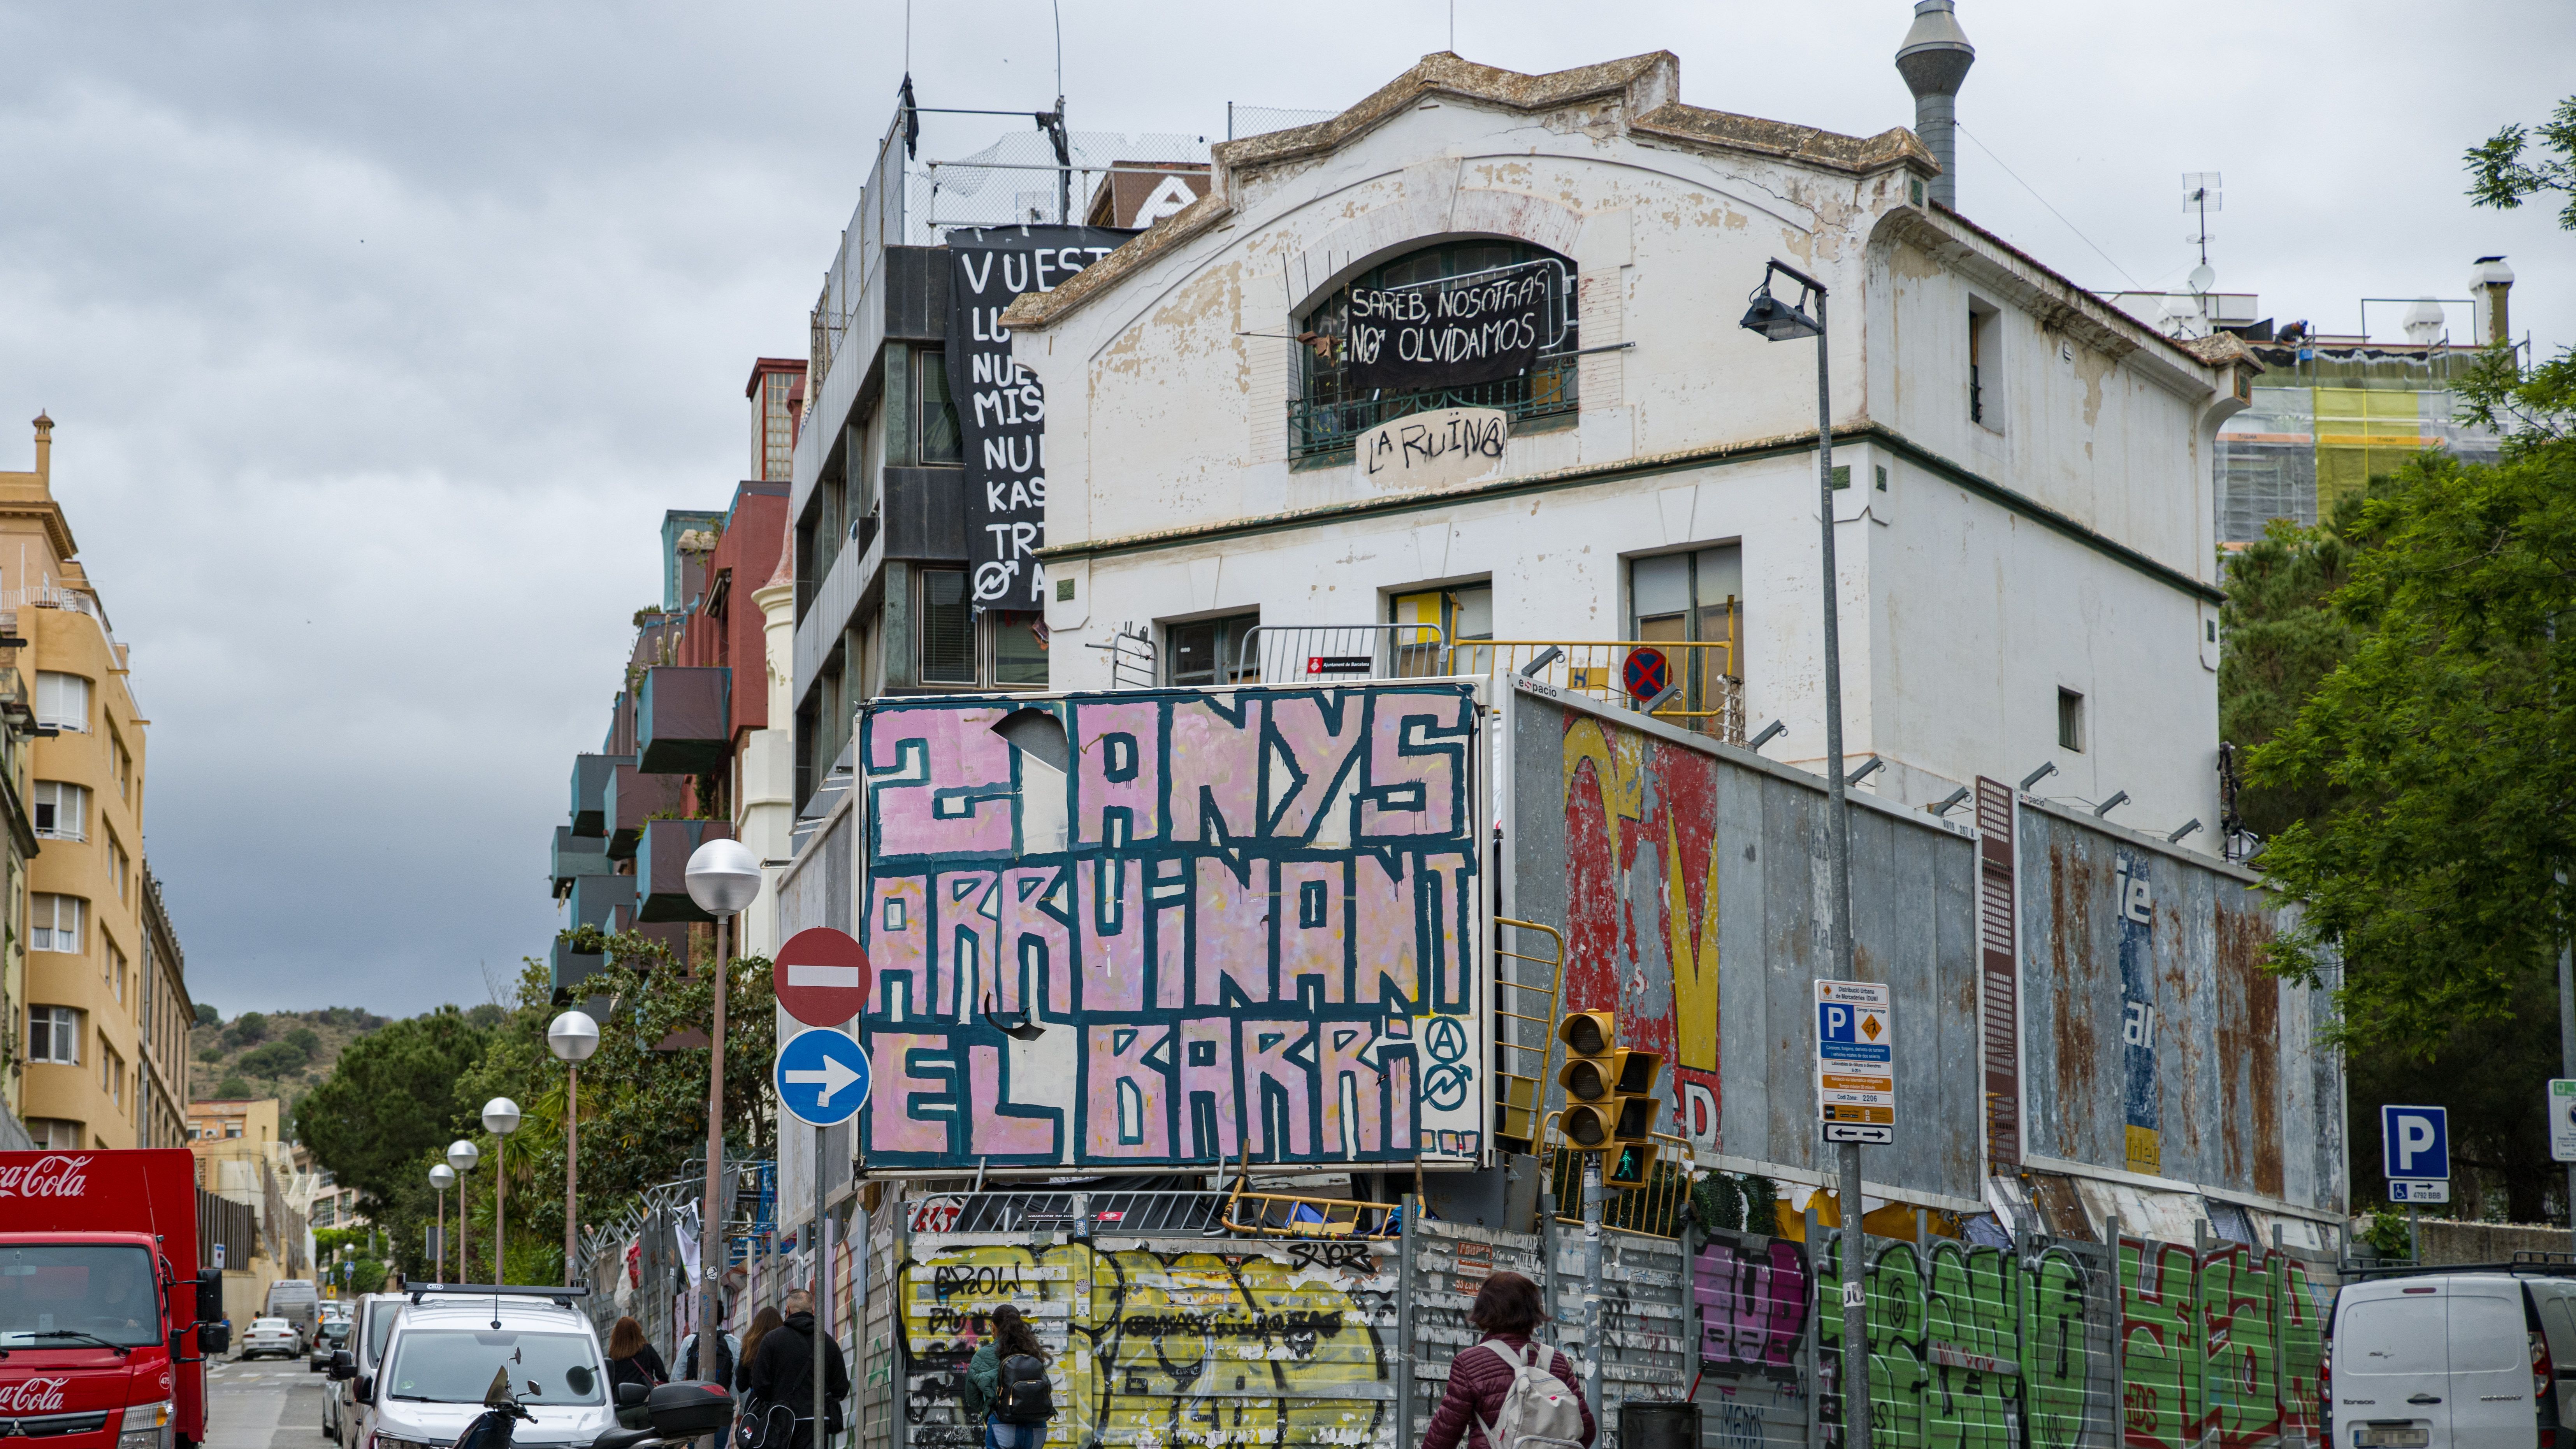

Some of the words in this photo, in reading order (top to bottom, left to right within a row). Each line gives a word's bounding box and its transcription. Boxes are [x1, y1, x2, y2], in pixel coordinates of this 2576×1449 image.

[1353, 287, 1430, 324] SAREB,
[1437, 269, 1548, 318] NOSOTRAS
[974, 385, 1044, 428] MIS
[1369, 430, 1392, 474] LA
[863, 701, 1022, 866] 2
[1069, 685, 1475, 850] ANYS
[1828, 1007, 1846, 1038] P
[862, 1022, 1065, 1166] EL
[2398, 1115, 2435, 1170] P
